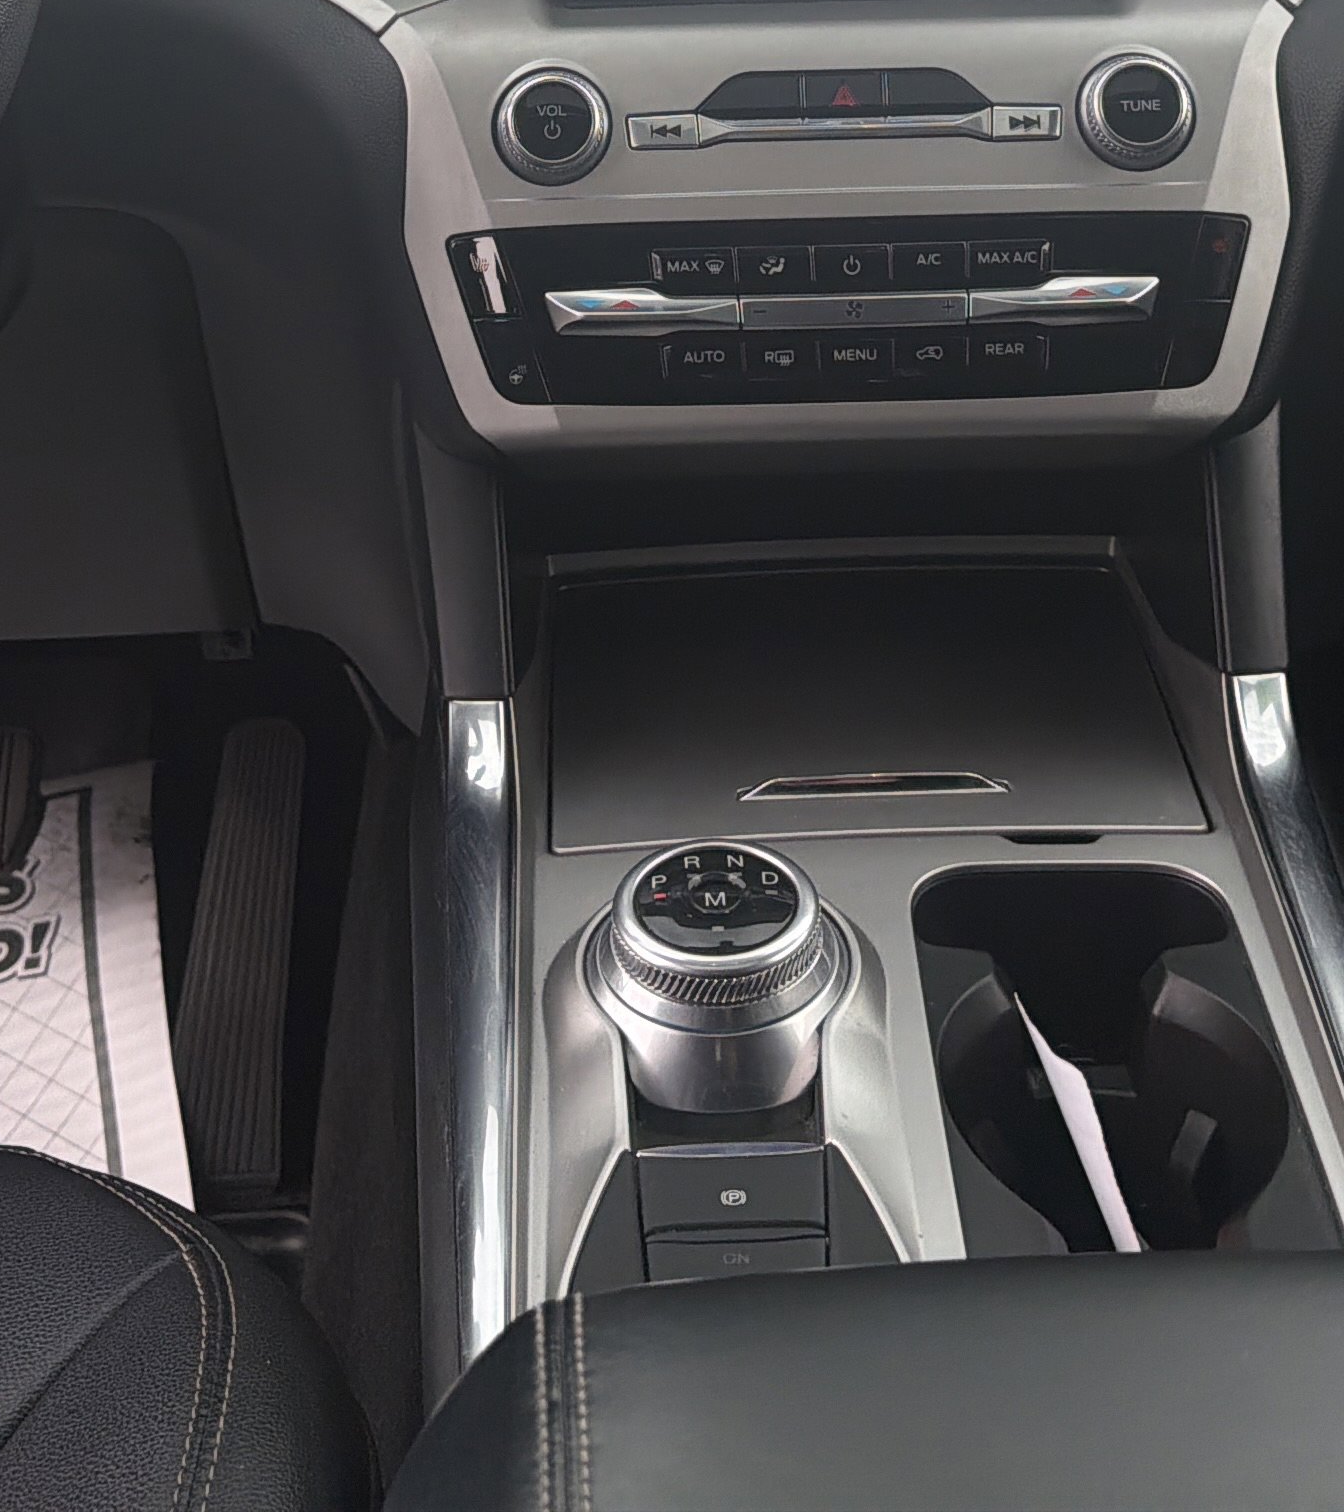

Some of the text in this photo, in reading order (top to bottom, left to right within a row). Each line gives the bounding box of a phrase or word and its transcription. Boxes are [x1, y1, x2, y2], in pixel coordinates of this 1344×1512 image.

[536, 104, 567, 117] VOL
[1119, 99, 1161, 112] TUNE
[916, 253, 941, 266] A/C
[977, 251, 1038, 265] MAX A/C
[667, 260, 700, 273] MAX
[833, 349, 877, 362] MENU
[985, 343, 1025, 356] REAR
[683, 350, 725, 363] AUTO
[683, 855, 701, 869] R
[727, 854, 745, 869] N
[651, 875, 668, 889] P
[760, 870, 779, 885] D
[704, 892, 727, 908] M
